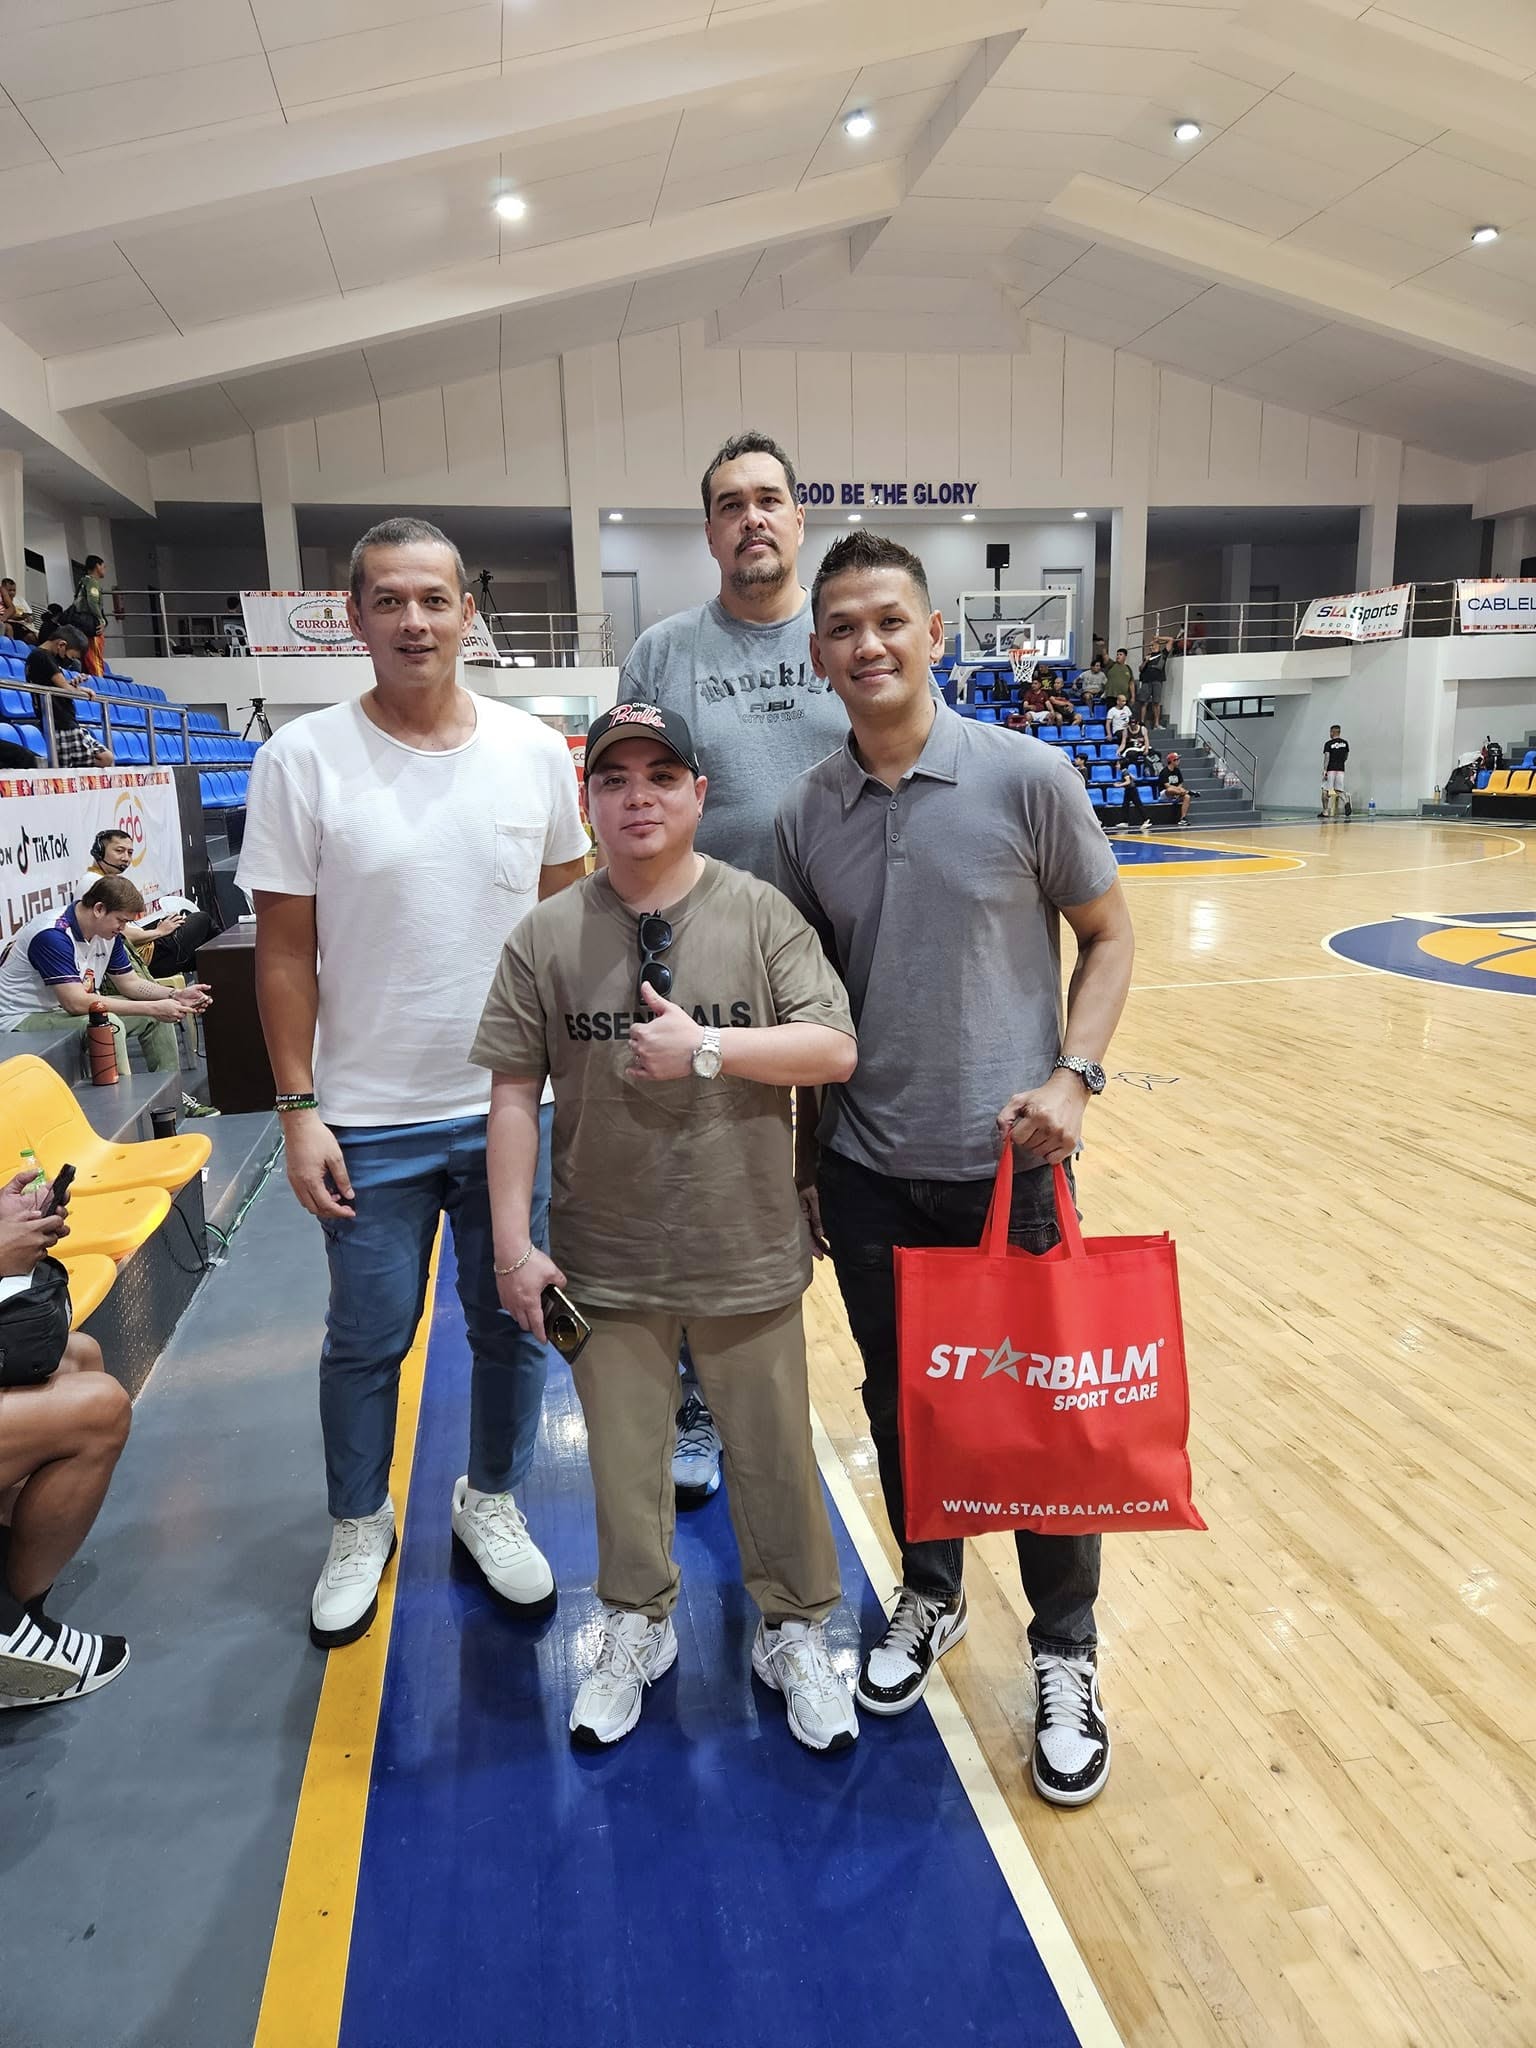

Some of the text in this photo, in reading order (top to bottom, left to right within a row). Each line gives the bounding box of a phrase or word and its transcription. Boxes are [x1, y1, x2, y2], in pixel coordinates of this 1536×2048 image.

[796, 483, 977, 505] GOD BE THE GLORY
[1350, 603, 1399, 624] Sports
[696, 661, 834, 705] Brookly
[609, 704, 666, 728] Bulls
[750, 698, 795, 713] FUBU
[766, 713, 780, 723] OF
[32, 833, 70, 863] TikTok
[564, 1001, 752, 1042] ESSEALS
[1053, 1382, 1158, 1411] SPORT CARE
[942, 1498, 1169, 1517] WWW.STARBALM.COM
